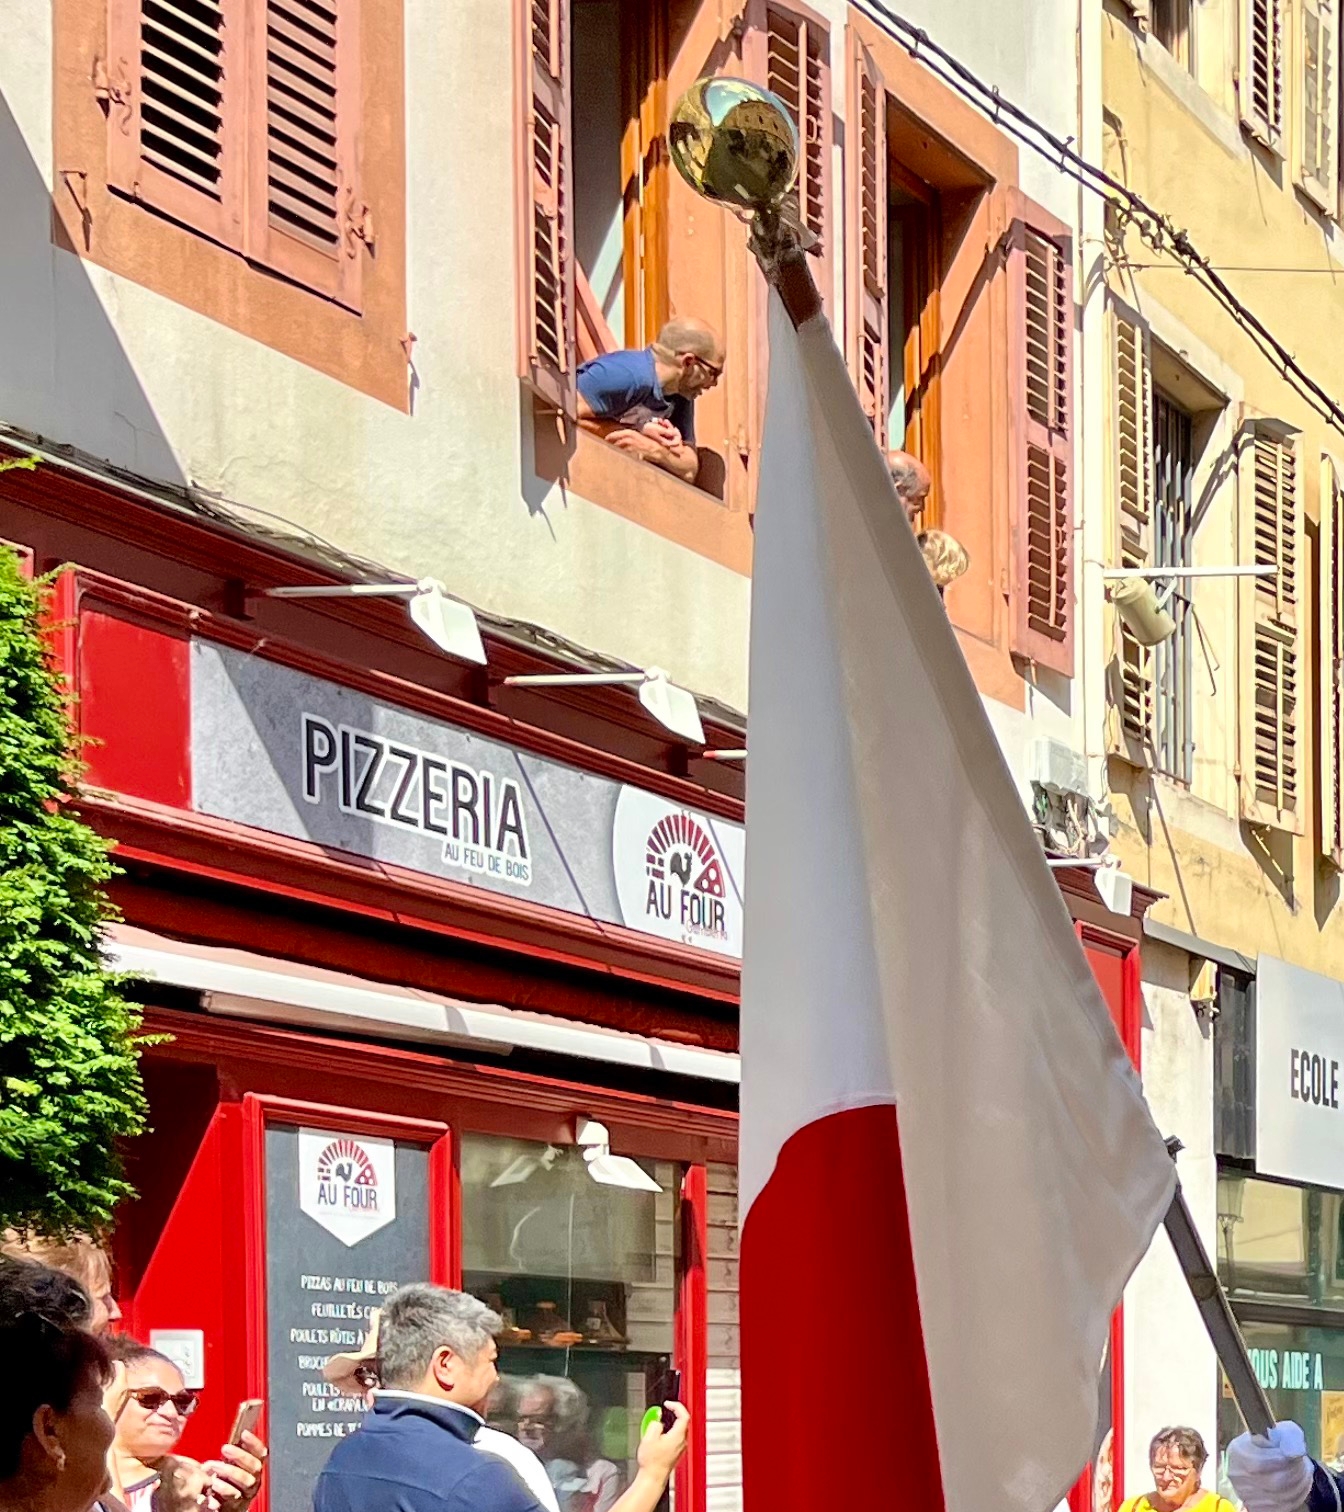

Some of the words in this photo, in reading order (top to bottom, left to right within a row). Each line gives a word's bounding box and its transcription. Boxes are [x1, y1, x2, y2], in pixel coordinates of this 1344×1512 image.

[306, 718, 528, 859] PIZZERIA
[445, 844, 459, 862] AU
[464, 850, 484, 869] FEU
[488, 854, 501, 874] DE
[506, 860, 529, 881] BOIS
[646, 879, 671, 920] AU
[681, 889, 725, 932] FOUR
[1291, 1048, 1339, 1109] ECOLE
[318, 1183, 337, 1206] AU
[344, 1186, 378, 1211] FOUR
[301, 1275, 331, 1291] PIZZAS
[333, 1277, 345, 1291] AU
[347, 1278, 363, 1293] FEU
[365, 1280, 376, 1294] DE
[290, 1328, 329, 1344] POULETS
[1248, 1349, 1278, 1389] OUS
[1282, 1351, 1310, 1390] AIDE
[1314, 1353, 1324, 1390] A
